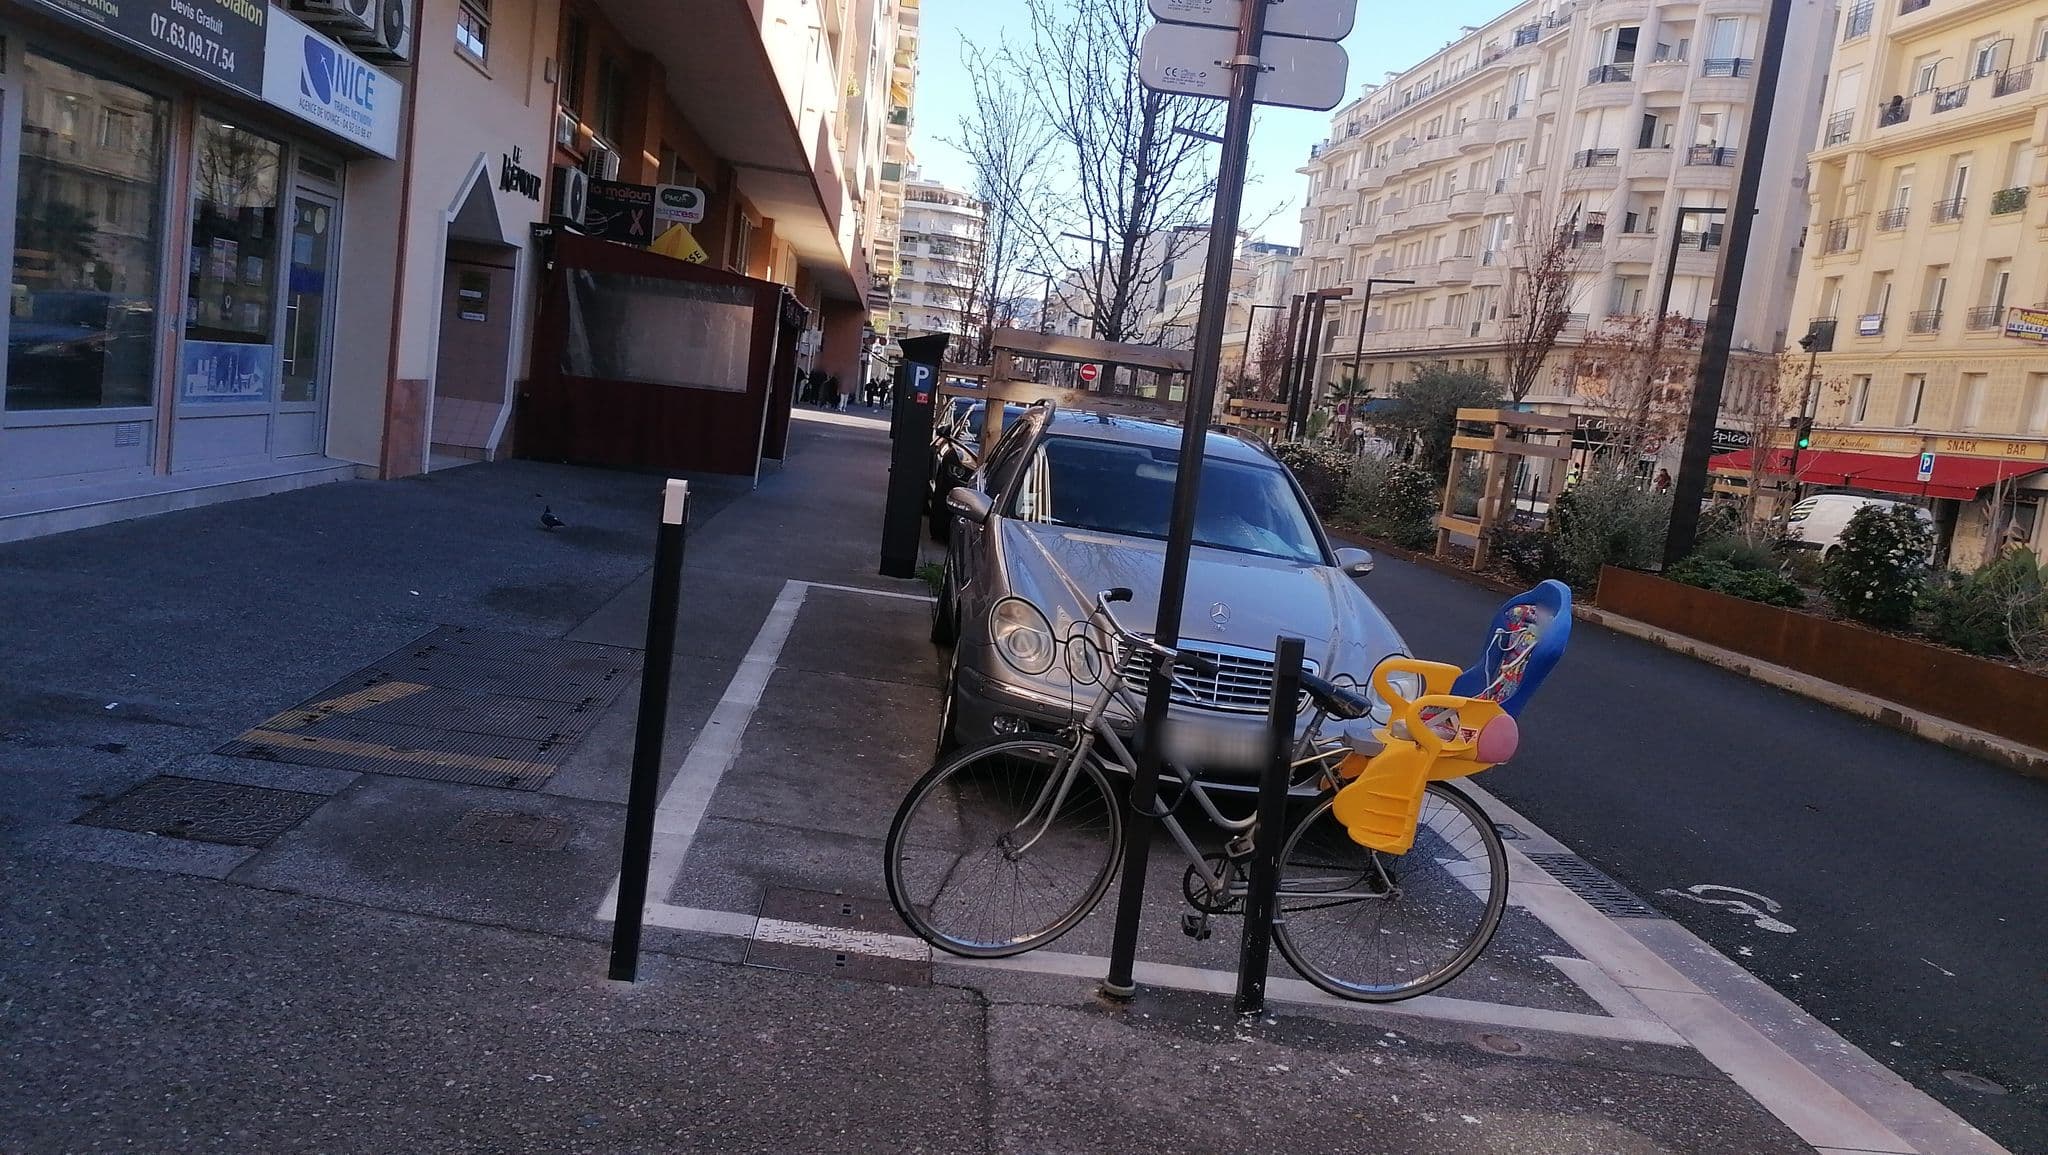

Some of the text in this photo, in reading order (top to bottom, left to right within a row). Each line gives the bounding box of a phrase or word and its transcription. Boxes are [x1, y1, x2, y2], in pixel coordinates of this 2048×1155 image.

[170, 0, 223, 35] Devis Gratuit
[150, 12, 235, 73] 07.63.09.77.54
[336, 54, 375, 110] NICE
[914, 366, 929, 387] P
[1946, 440, 2027, 456] SNACK BAR
[1922, 457, 1931, 471] P
